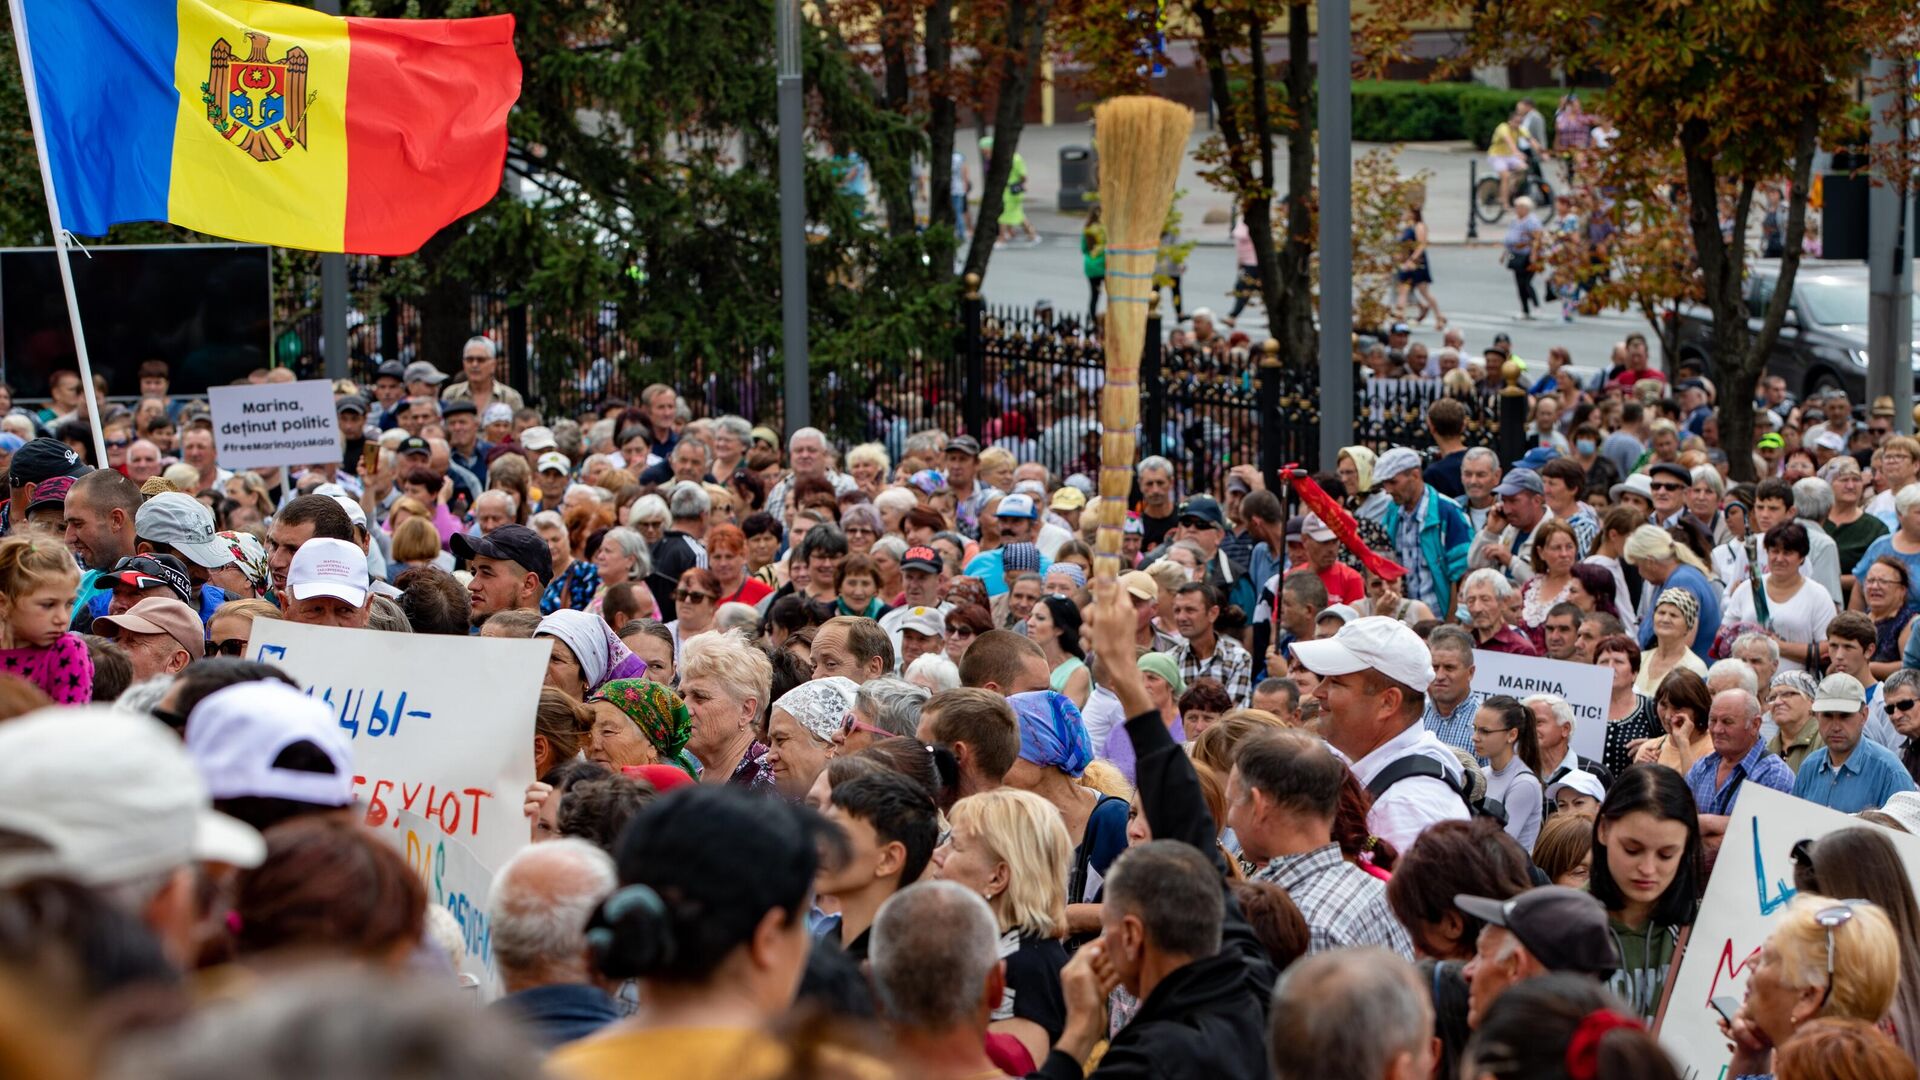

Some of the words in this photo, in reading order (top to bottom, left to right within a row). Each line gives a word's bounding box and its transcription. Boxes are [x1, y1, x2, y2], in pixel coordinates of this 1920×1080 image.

[242, 399, 304, 413] Marina,
[221, 420, 277, 437] deținut
[282, 415, 330, 433] politic
[1498, 674, 1568, 698] MARINA,
[1568, 703, 1602, 720] TIC!
